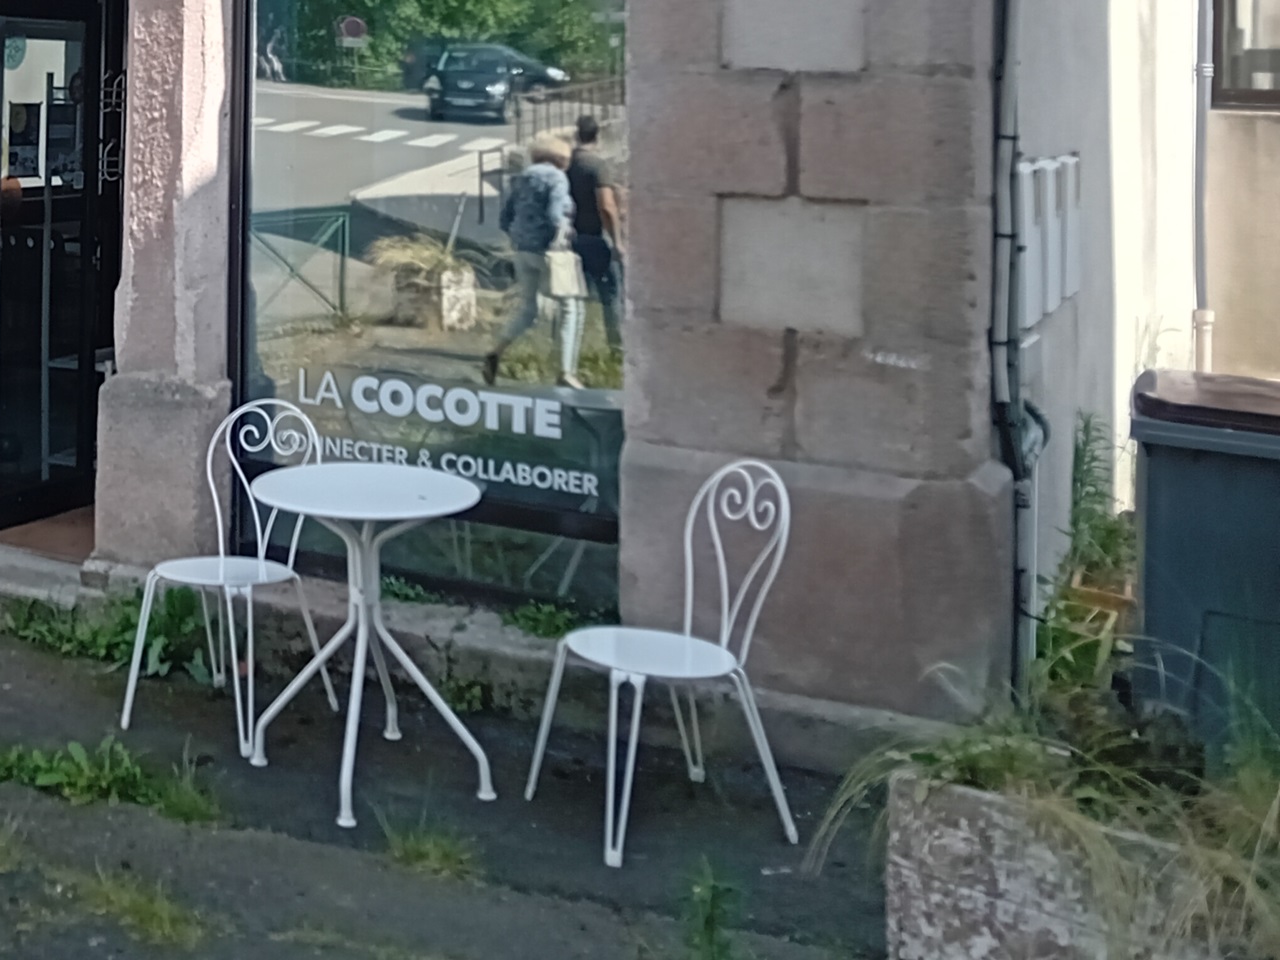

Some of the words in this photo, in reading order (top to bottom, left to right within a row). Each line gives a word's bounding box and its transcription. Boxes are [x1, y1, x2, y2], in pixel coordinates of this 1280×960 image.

[297, 368, 343, 409] LA
[351, 375, 563, 440] COCOTTE
[417, 448, 433, 469] &
[440, 452, 600, 497] COLLABORER
